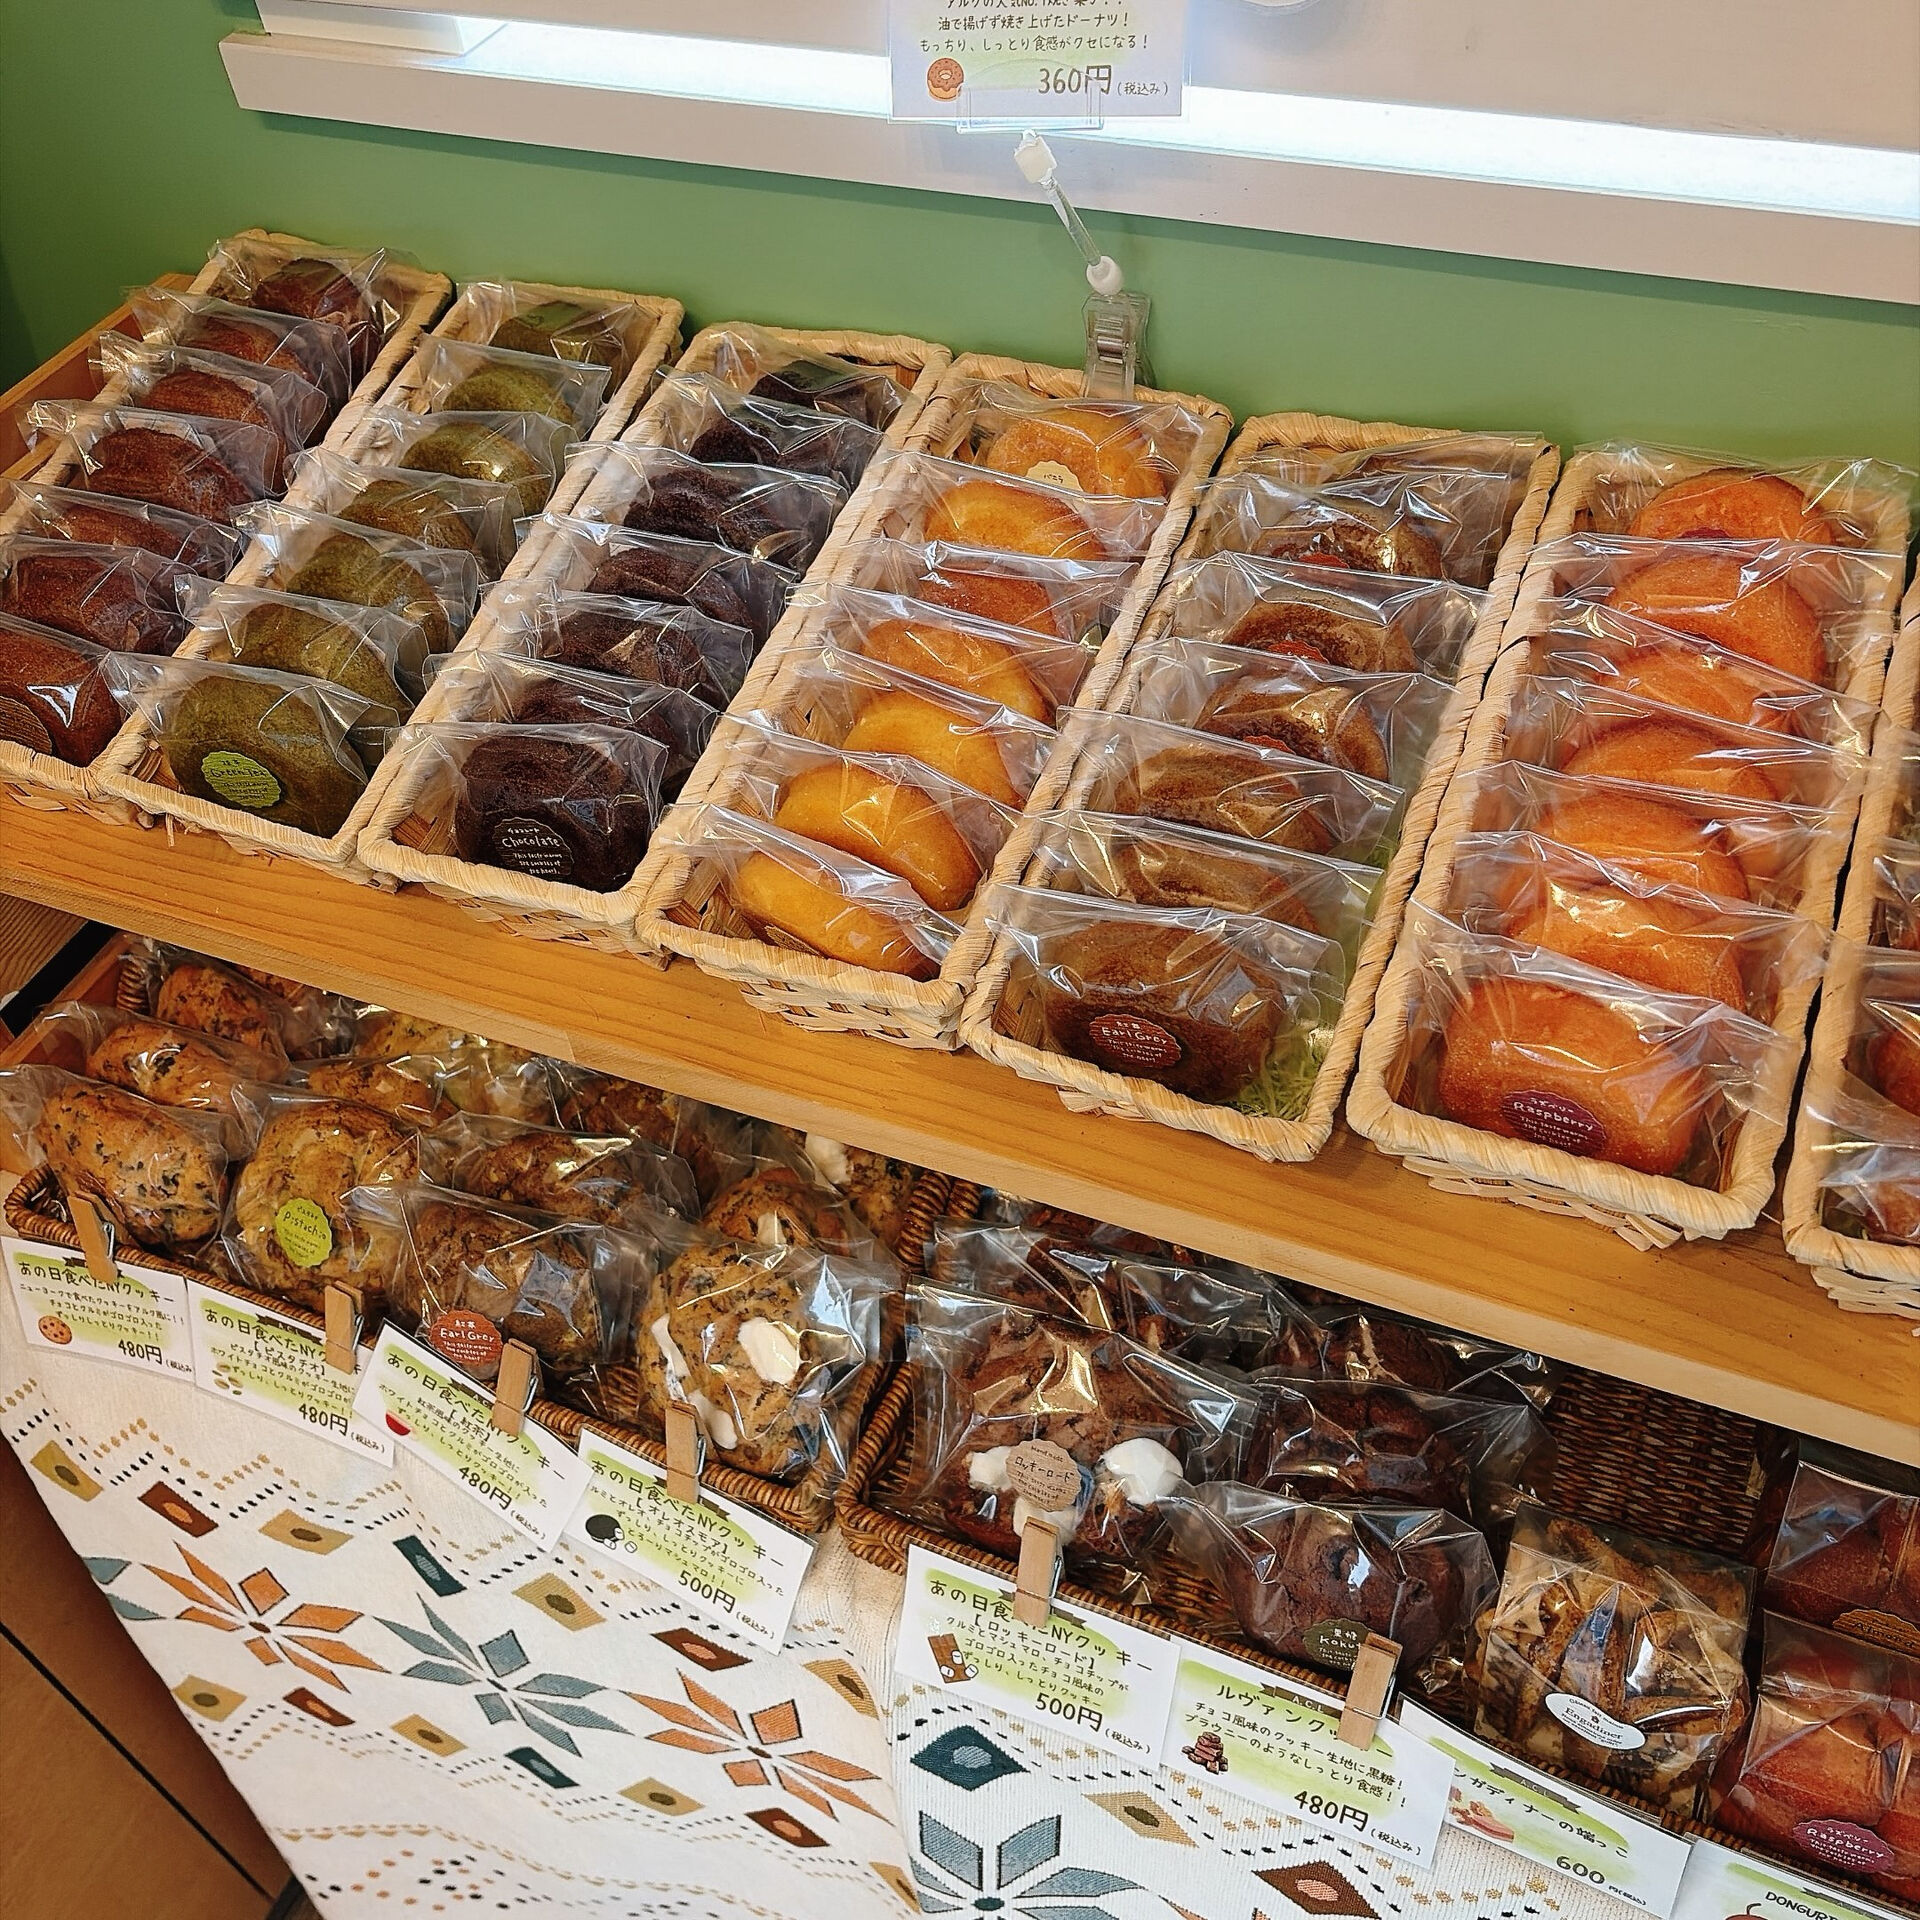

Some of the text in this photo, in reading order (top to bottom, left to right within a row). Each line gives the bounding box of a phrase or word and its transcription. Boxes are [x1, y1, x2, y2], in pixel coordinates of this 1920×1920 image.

[938, 13, 1128, 31] 油で揚げず焼き上げたドーナツ！
[920, 34, 1150, 53] もっちり、しっとり食感がクセになる！
[1038, 65, 1112, 95] 360円
[502, 835, 560, 848] Chocolate
[1101, 1026, 1168, 1045] Earl Grey
[1513, 1101, 1594, 1131] Raspberry
[282, 1210, 327, 1240] Pistachio
[18, 1261, 175, 1303] あの日食べたNYクッキー
[118, 1339, 193, 1373] 480円 （税込み
[204, 1308, 362, 1376] あの日食べたNYクキ
[440, 1327, 495, 1343] Earl Grey
[210, 1346, 353, 1405] ホワイトチョコとクルミがゴロゴロが
[254, 1340, 326, 1375] 【ピスタチオ】
[298, 1403, 349, 1437] 480円
[387, 1352, 566, 1480] あの日食べたNクッキー
[449, 1408, 491, 1443] 【紅茶】
[458, 1466, 513, 1511] 480円
[1014, 1456, 1075, 1483] ロッキーロード
[591, 1459, 785, 1567] あの日食べたNYクッキー
[636, 1496, 728, 1554] 【オレオスモア】
[590, 1485, 784, 1597] ルミとオレオ、チョコチップがゴロゴロ入った
[616, 1508, 745, 1586] ずっしり、しっとりクッキーに
[627, 1527, 726, 1588] とろーりマシュマロ！！
[678, 1570, 737, 1615] 500円
[929, 1579, 1153, 1672] あの日食NYクッキー
[973, 1613, 1097, 1670] 【ロッキーロード】
[1319, 1635, 1361, 1650] Kokut
[946, 1616, 1130, 1692] クルミとマシュマロ、チョコチップが
[964, 1638, 1105, 1697] ゴロゴロ入ったチョコ風味の
[962, 1650, 1102, 1707] ずっしり、しっとりクッキー
[1035, 1692, 1104, 1733] 500円
[1216, 1684, 1393, 1758] ルヴァンクッー
[1564, 1706, 1623, 1740] Engadiner
[1184, 1712, 1406, 1808] ブラウニーのようなしっとり食感！！
[1194, 1701, 1405, 1791] チョコ風味のクッキー生地に黒糖！
[1293, 1790, 1370, 1833] 480円
[1453, 1767, 1628, 1859] ンガディナーの端っこ
[1806, 1827, 1884, 1858] Raspberry
[1556, 1856, 1606, 1885] 600
[1765, 1891, 1837, 1920] DONGUR
